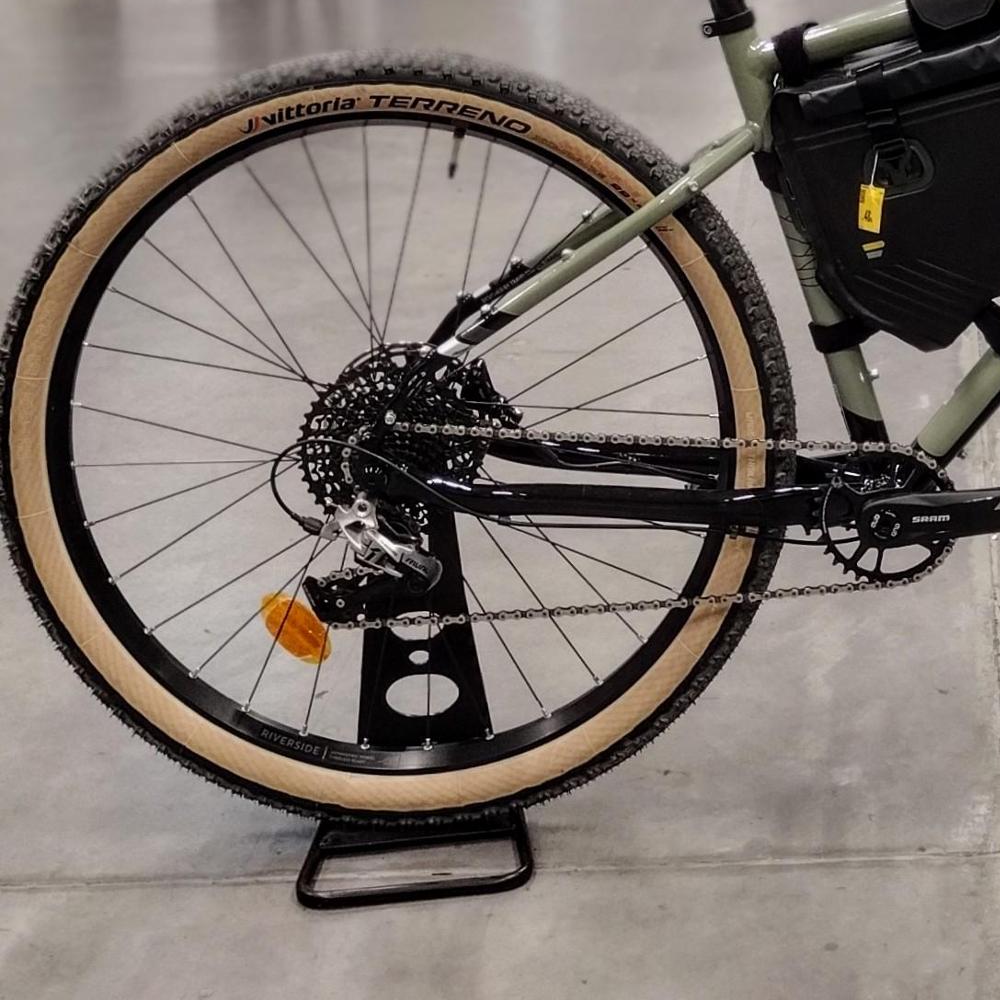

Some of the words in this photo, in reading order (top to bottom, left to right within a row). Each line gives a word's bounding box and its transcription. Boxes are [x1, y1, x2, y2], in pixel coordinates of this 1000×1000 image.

[261, 96, 356, 128] vittoria
[369, 95, 532, 135] TERRENO
[911, 514, 951, 524] SRAM
[260, 729, 321, 756] RIVERSIDE
